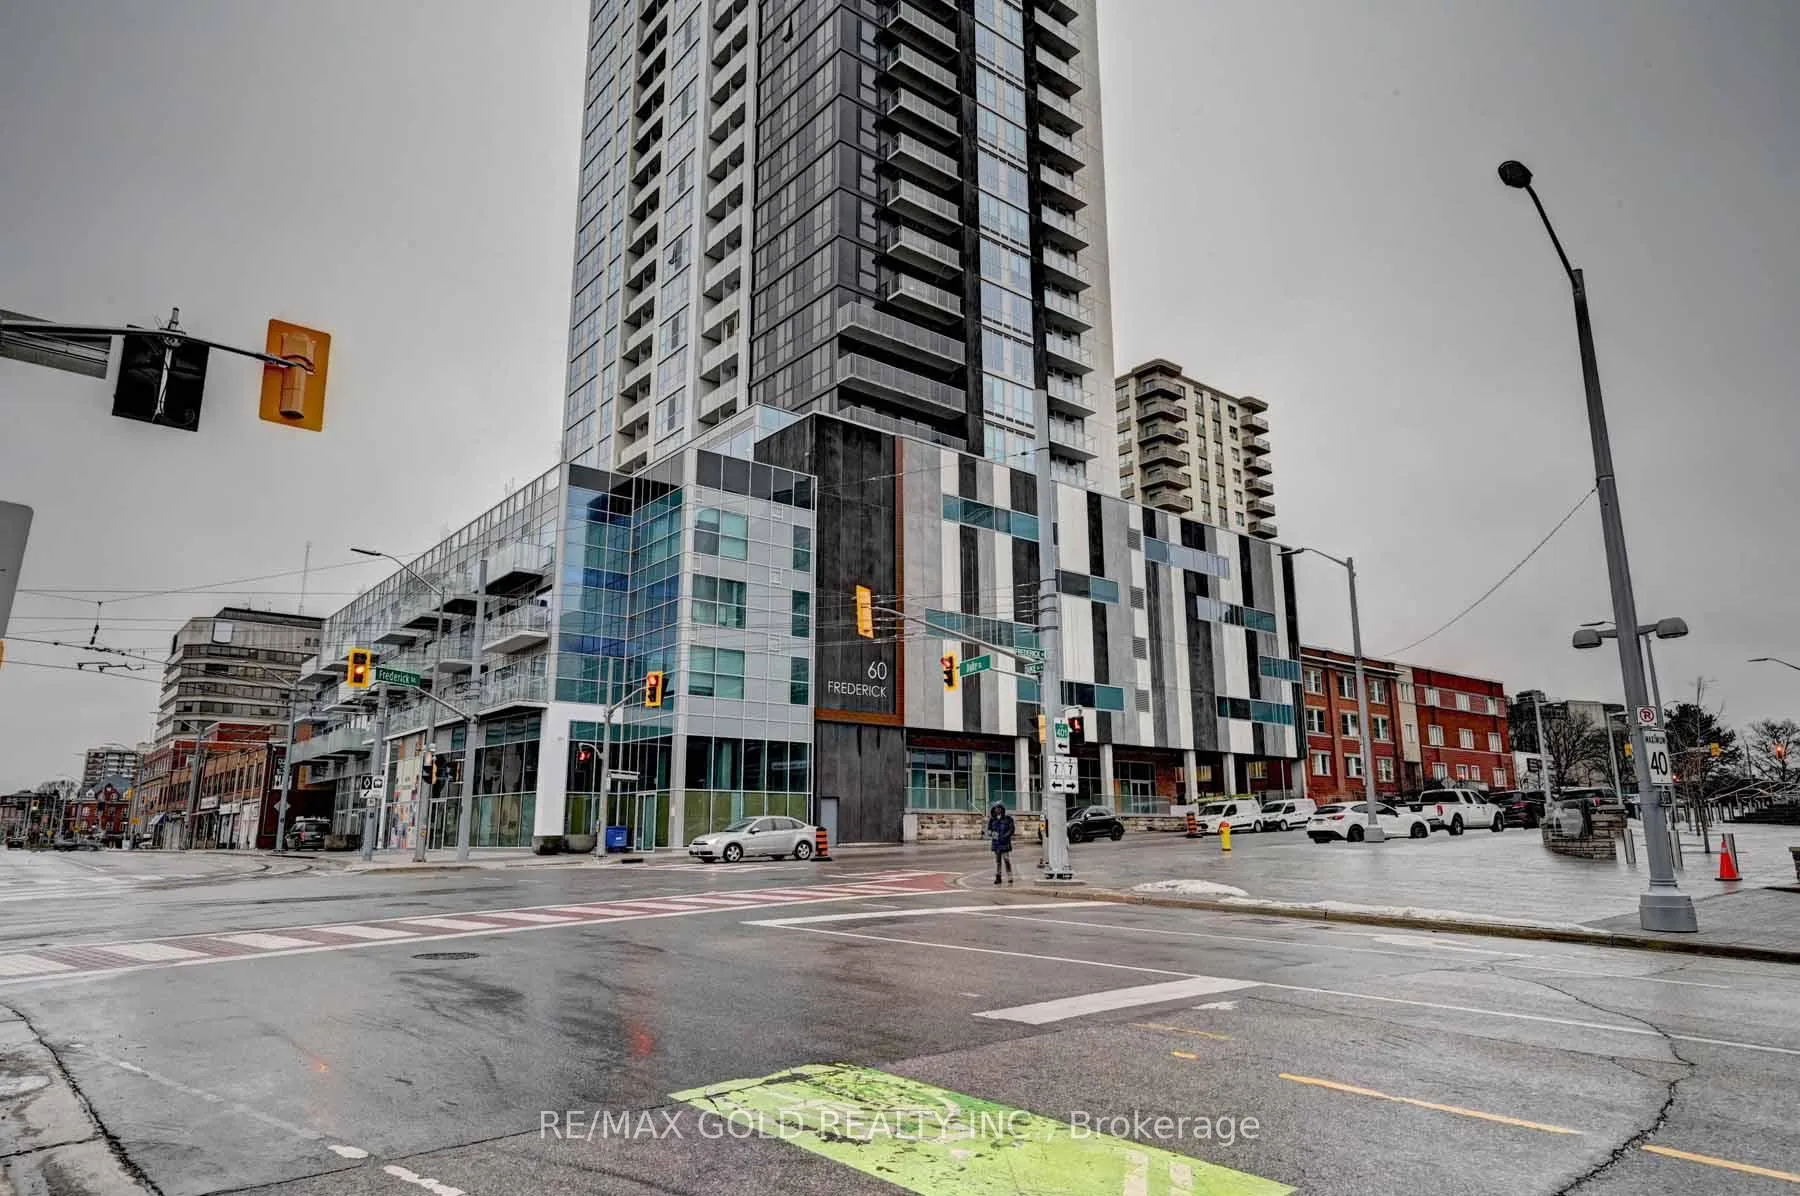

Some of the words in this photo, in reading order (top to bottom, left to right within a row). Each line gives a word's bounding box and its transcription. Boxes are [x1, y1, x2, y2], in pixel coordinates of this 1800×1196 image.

[379, 669, 410, 684] Frederick
[867, 661, 888, 680] 60
[827, 680, 887, 697] FREDERICK
[1056, 727, 1068, 737] 401
[1651, 752, 1668, 776] 40
